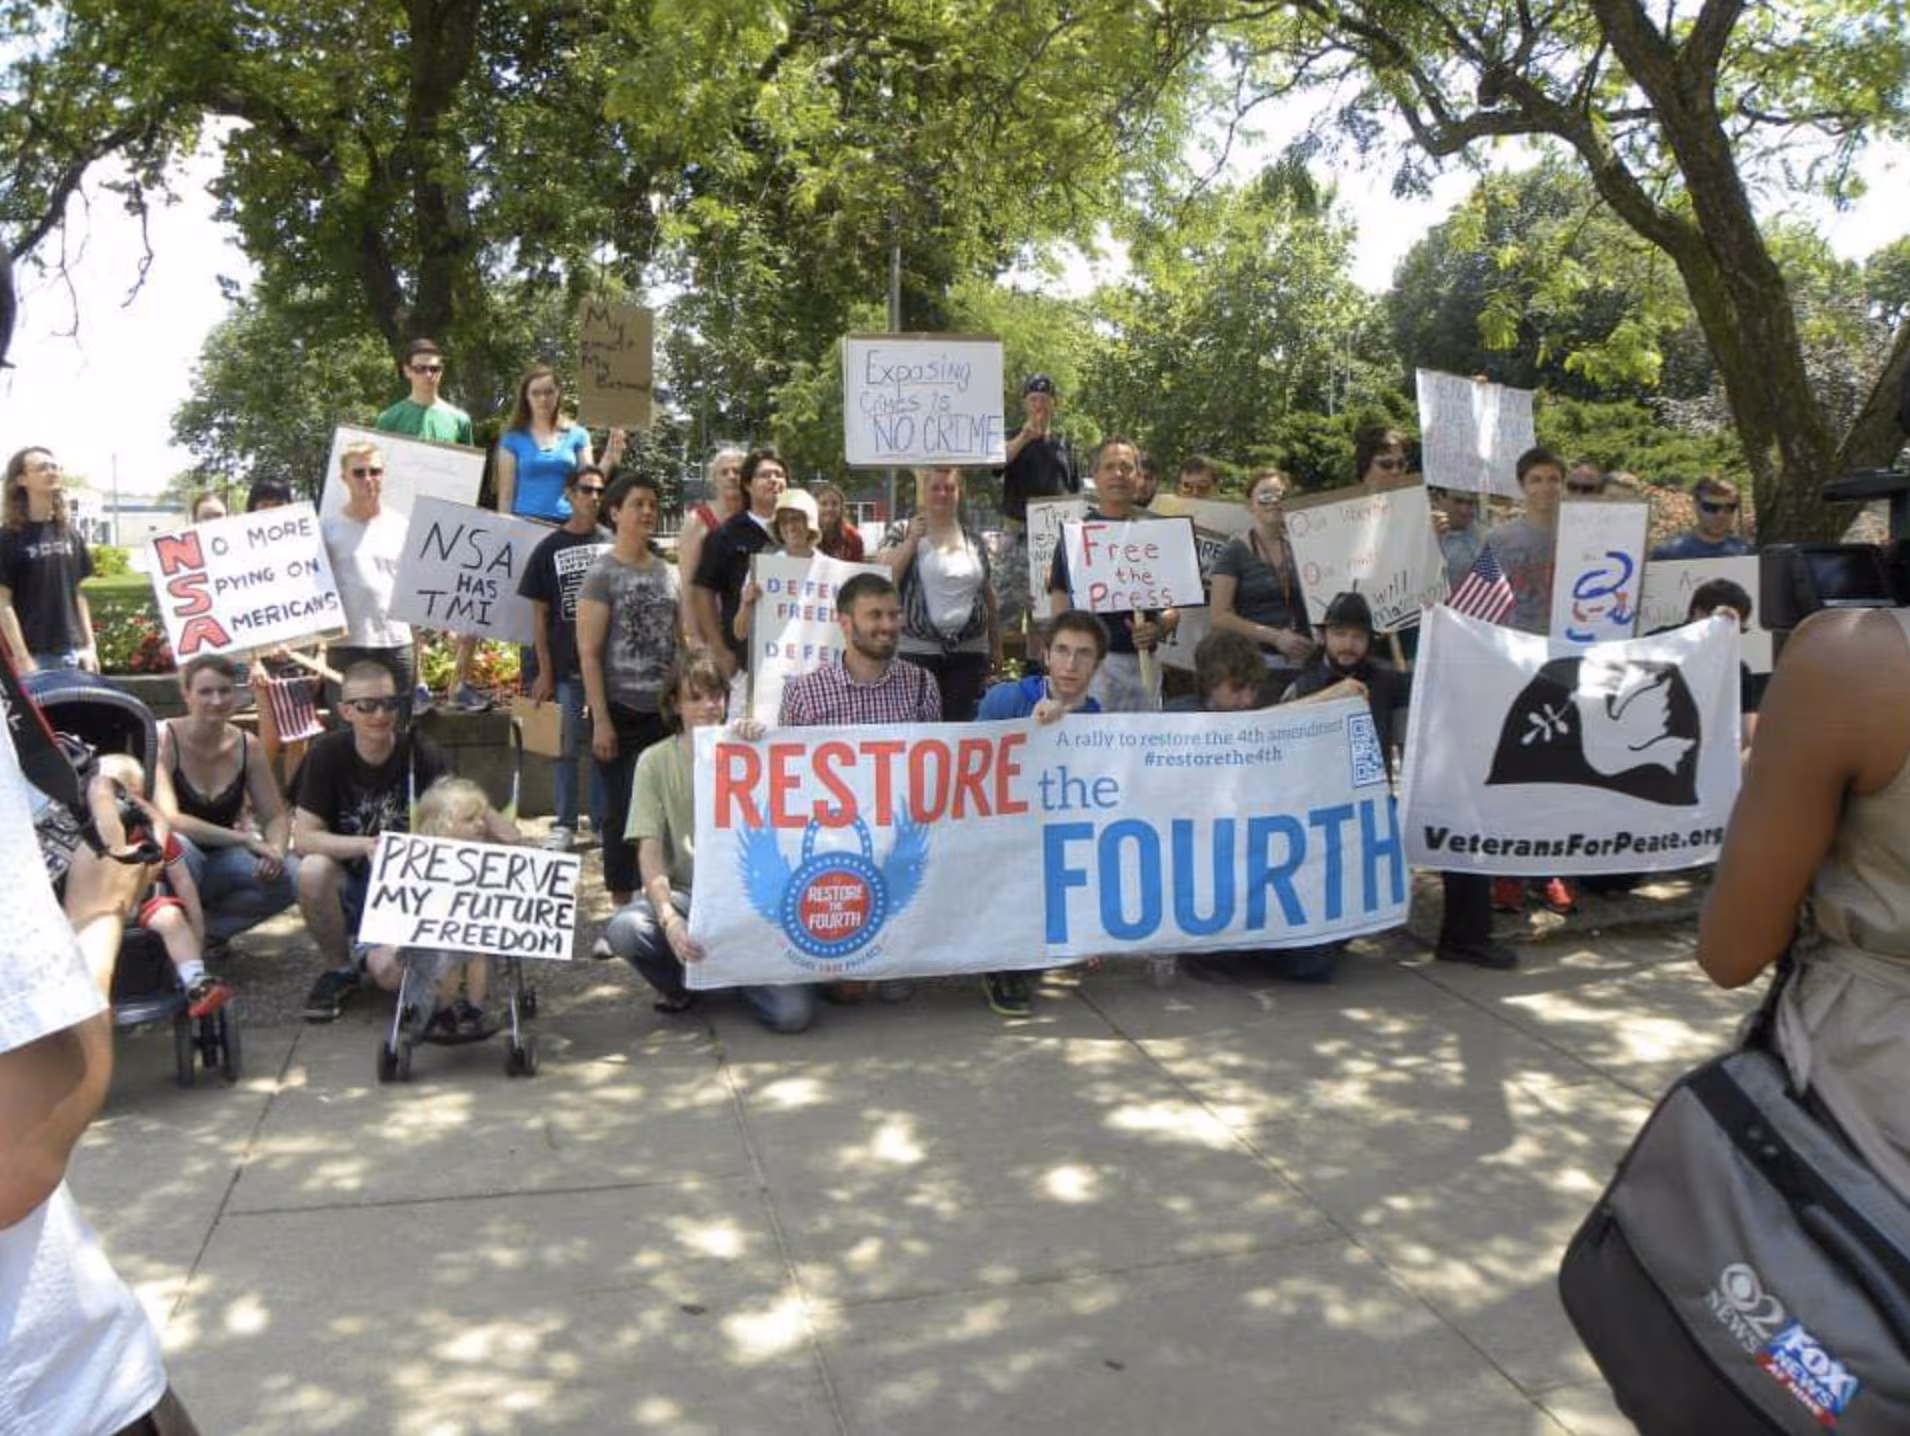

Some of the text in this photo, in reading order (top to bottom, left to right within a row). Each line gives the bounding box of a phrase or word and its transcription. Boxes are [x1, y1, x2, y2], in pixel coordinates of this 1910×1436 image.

[866, 350, 971, 397] Exposing
[874, 414, 1003, 456] NO CRIME
[247, 518, 312, 549] MORE
[419, 521, 514, 578] NSA
[1081, 524, 1160, 567] Free
[287, 558, 320, 577] ON
[457, 573, 498, 599] HAS
[1116, 568, 1154, 585] the
[416, 590, 493, 625] TMI
[1088, 582, 1174, 612] Press
[1056, 731, 1071, 747] A
[1075, 730, 1113, 749] rally
[1119, 731, 1137, 747] to
[1140, 730, 1199, 747] restore
[1204, 728, 1233, 745] the
[1237, 723, 1265, 743] 4th
[1145, 748, 1283, 768] #restorethe4th
[714, 733, 1029, 829] RESTORE
[1038, 766, 1120, 811] the
[378, 835, 578, 901] PRESERVE
[1043, 797, 1405, 945] FOURTH
[371, 884, 574, 930] MY FUTURE
[808, 885, 863, 902] RESTORE
[409, 919, 563, 954] FREEDOM
[809, 911, 861, 930] FOURTH
[1705, 1289, 1761, 1354] NEWS
[1772, 1351, 1834, 1408] NEWS
[1782, 1324, 1855, 1399] FOX
